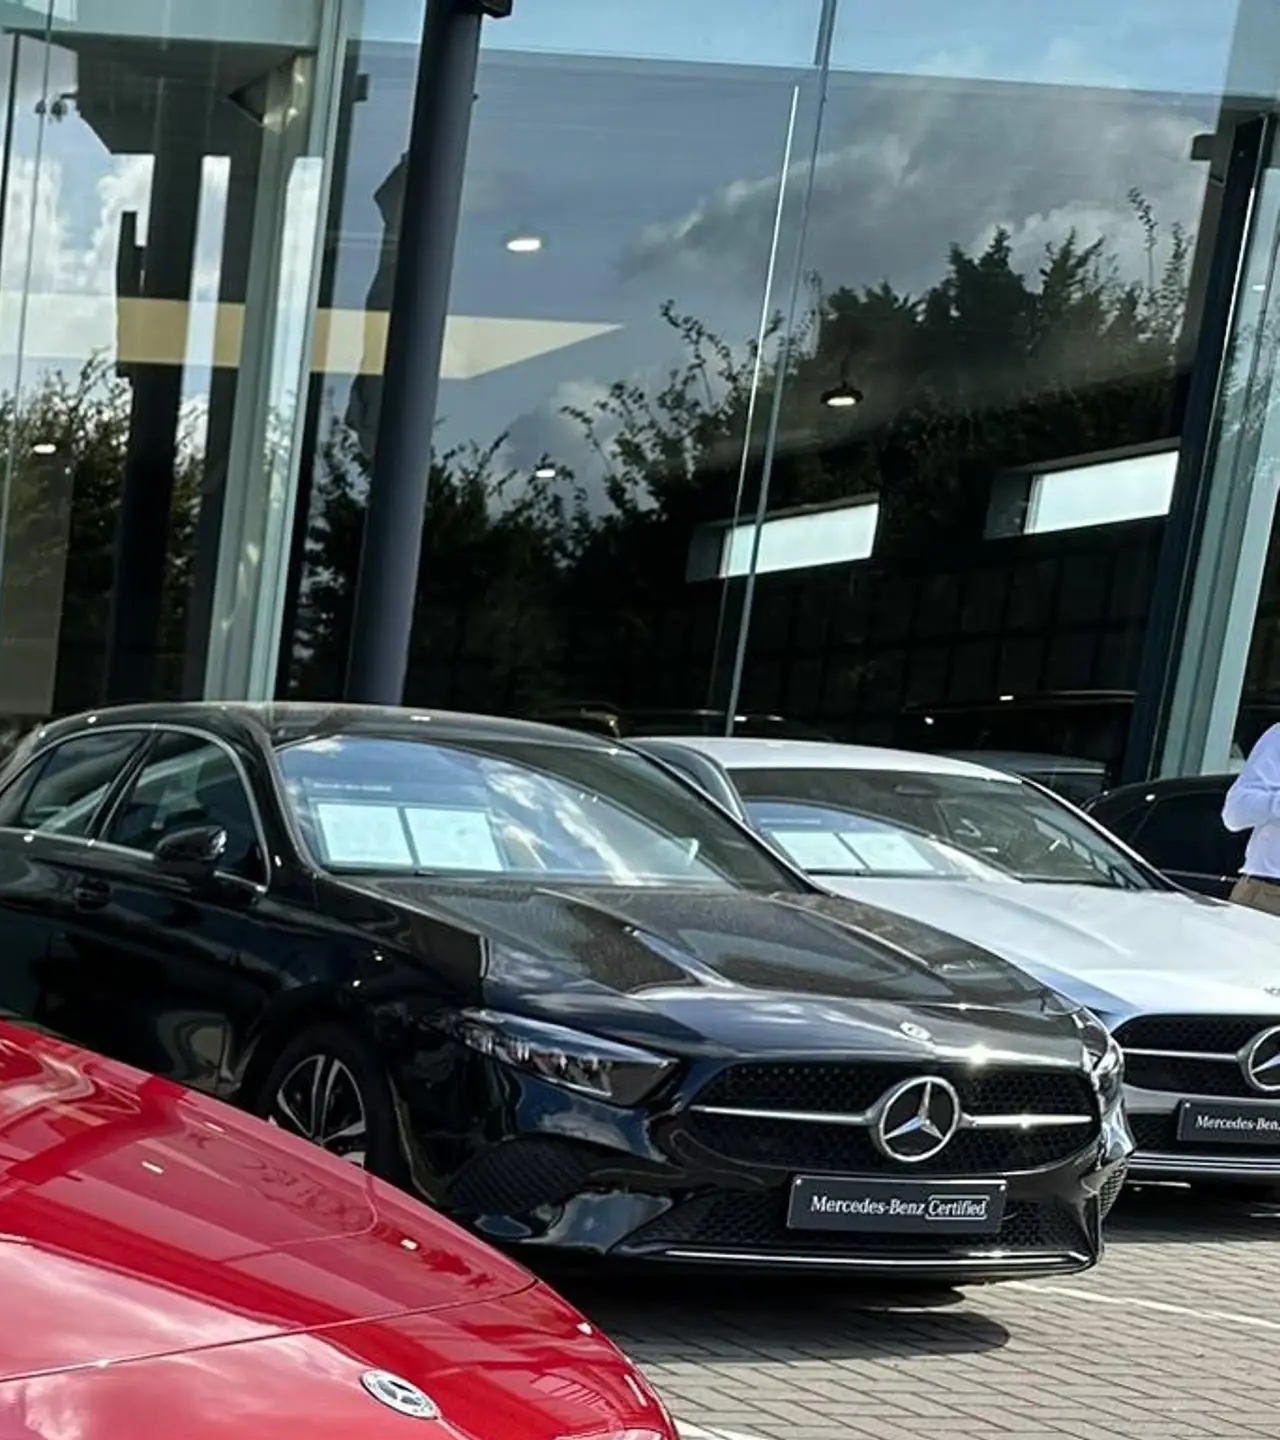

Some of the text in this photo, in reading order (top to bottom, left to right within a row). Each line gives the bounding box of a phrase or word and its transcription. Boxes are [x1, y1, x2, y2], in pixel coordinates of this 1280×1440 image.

[1195, 1114, 1280, 1131] Mercedes-Ben
[811, 1195, 987, 1217] Mercedes-Benz Certified
